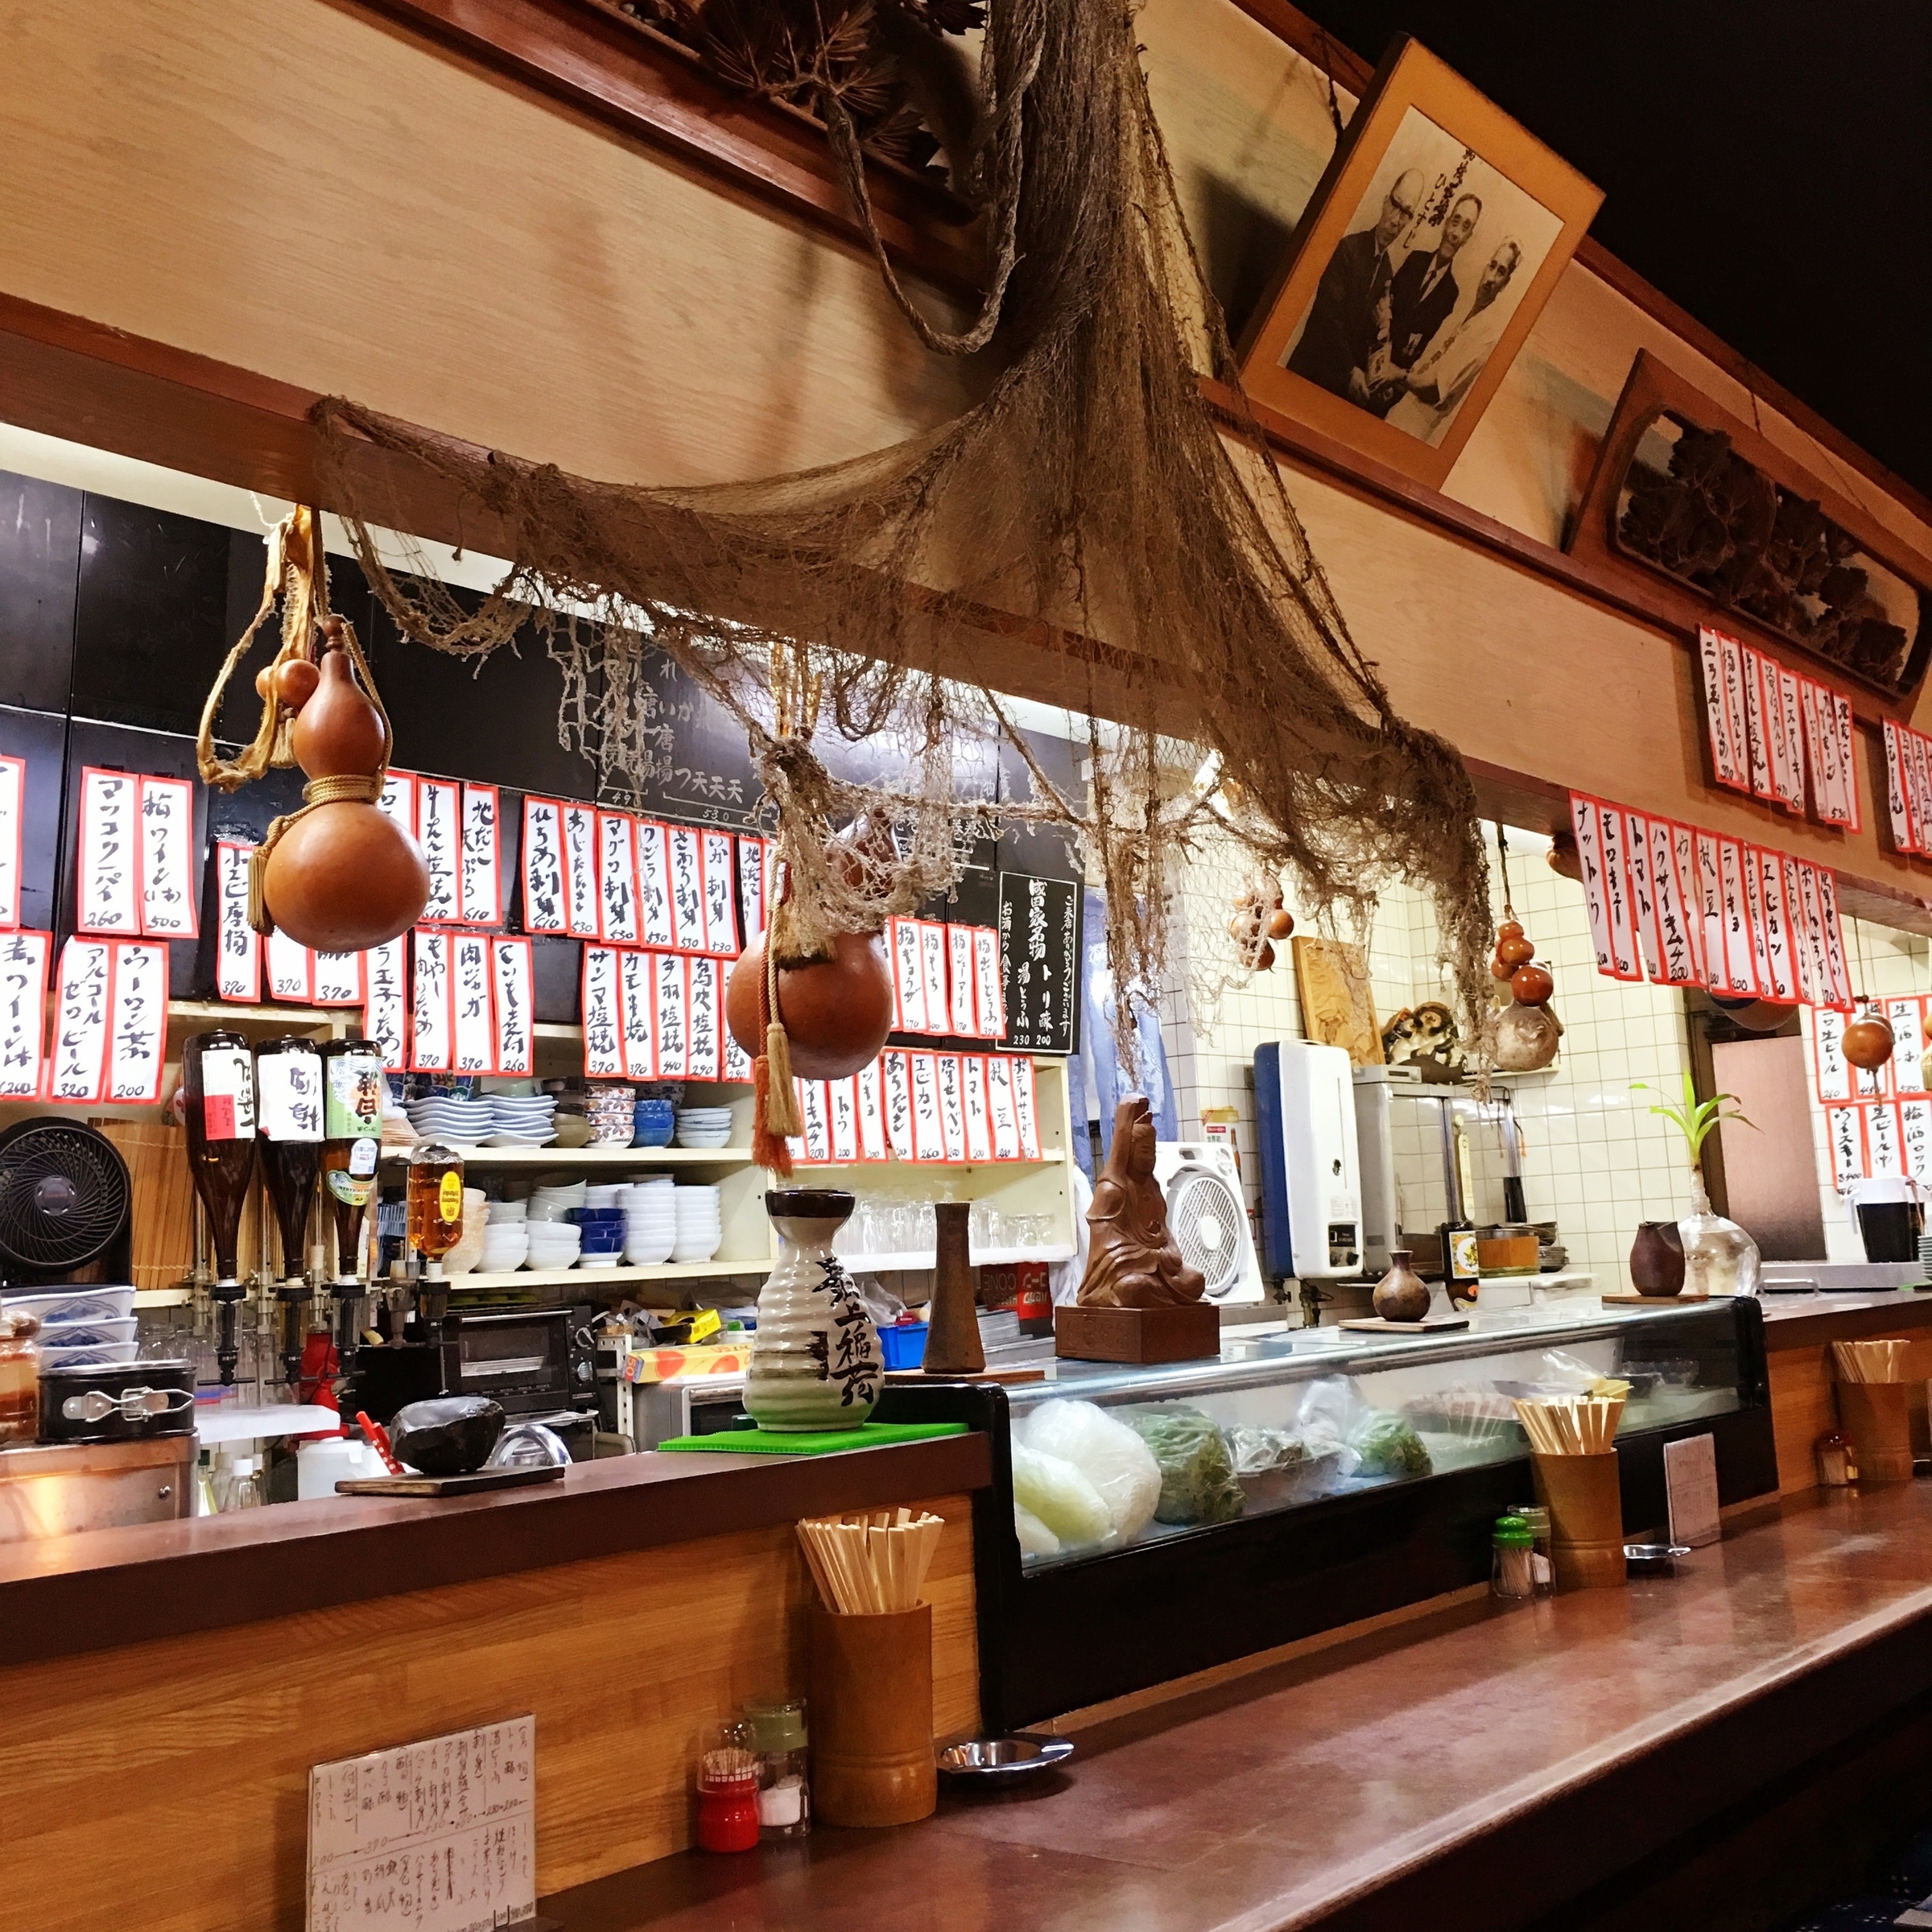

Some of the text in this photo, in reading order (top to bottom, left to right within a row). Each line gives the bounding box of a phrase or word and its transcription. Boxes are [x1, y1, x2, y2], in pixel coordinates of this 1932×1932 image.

[568, 808, 592, 933] あじたたき 530
[1630, 817, 1651, 917] トマト
[605, 819, 634, 941] マグロ刺身 530
[644, 828, 668, 944] クジラ刺身 530
[707, 838, 732, 952] いか刺身 530
[1653, 828, 1684, 968] ハクサイキムチ
[84, 910, 123, 927] 260
[422, 906, 449, 920] 610
[464, 907, 490, 921] 610
[147, 914, 182, 928] 500
[535, 918, 559, 931] 610
[680, 936, 699, 949] 530
[222, 980, 246, 996] 370
[276, 979, 301, 993] 370
[319, 986, 352, 1001] 370
[659, 955, 684, 1055] 手羽塩焼
[588, 951, 616, 1076] サンマ塩焼 370
[114, 947, 155, 1098] ウーロン茶 200
[1013, 1034, 1030, 1046] 230
[1036, 1034, 1051, 1046] 200
[419, 1055, 440, 1067] 370
[459, 1057, 483, 1071] 370
[503, 1059, 525, 1072] 260
[630, 1063, 647, 1075] 370
[691, 1064, 713, 1077] 290
[54, 1083, 89, 1098] 320
[968, 1058, 982, 1117] トマト
[1834, 1107, 1855, 1168] ウイスキー
[984, 1272, 1047, 1291] コーン CONE
